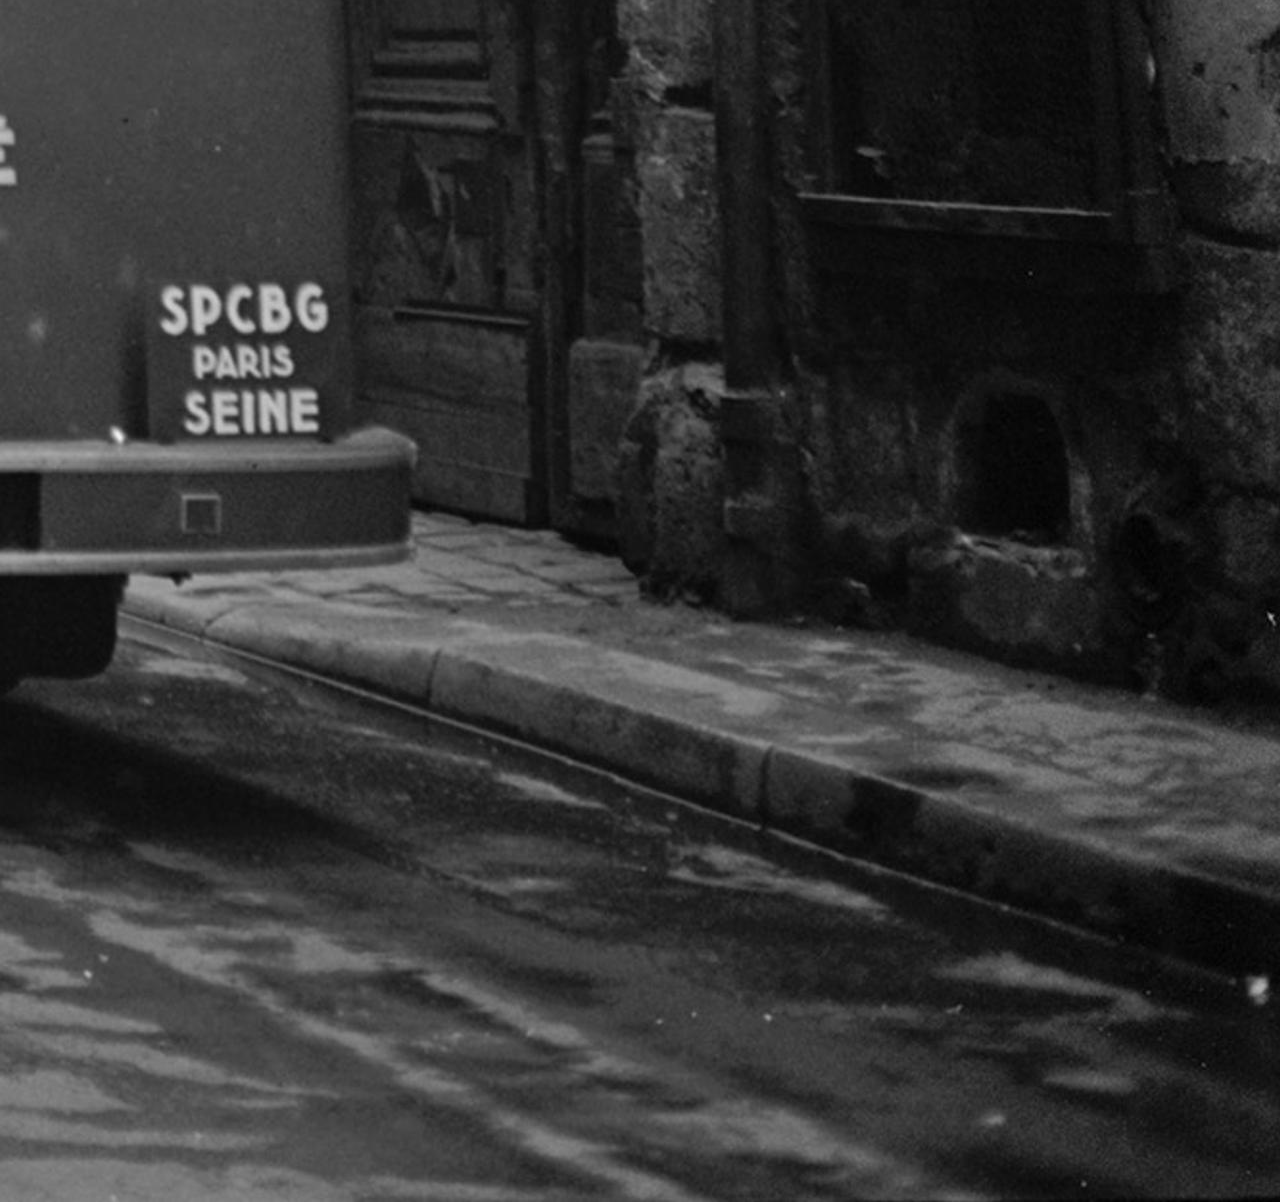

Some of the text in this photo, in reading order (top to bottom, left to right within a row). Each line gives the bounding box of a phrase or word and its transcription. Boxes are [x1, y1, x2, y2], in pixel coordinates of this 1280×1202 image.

[159, 282, 329, 335] SPCBG
[193, 344, 295, 379] PARIS
[183, 388, 320, 435] SEINE
